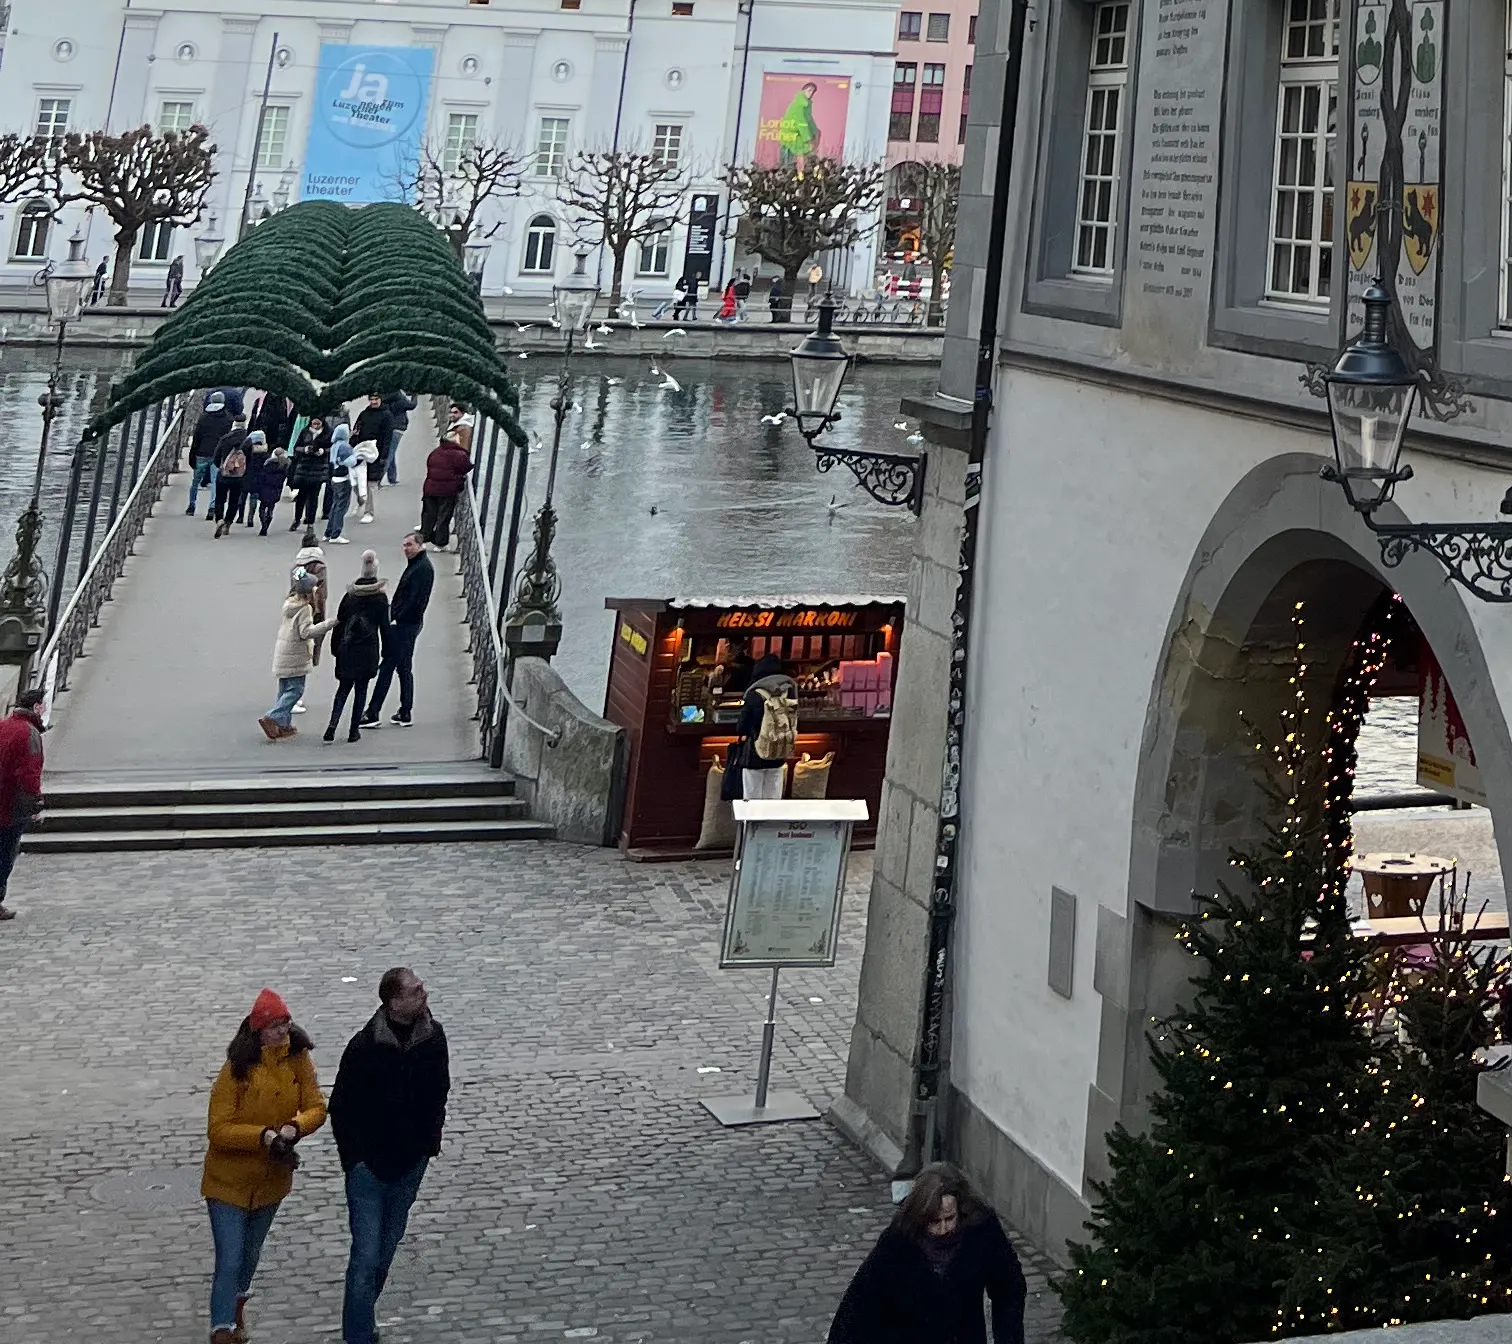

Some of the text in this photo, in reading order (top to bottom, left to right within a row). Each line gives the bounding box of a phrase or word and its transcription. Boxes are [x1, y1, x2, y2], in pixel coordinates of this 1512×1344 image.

[340, 64, 388, 106] ja
[350, 110, 391, 125] Theater
[717, 611, 775, 628] HEISSI
